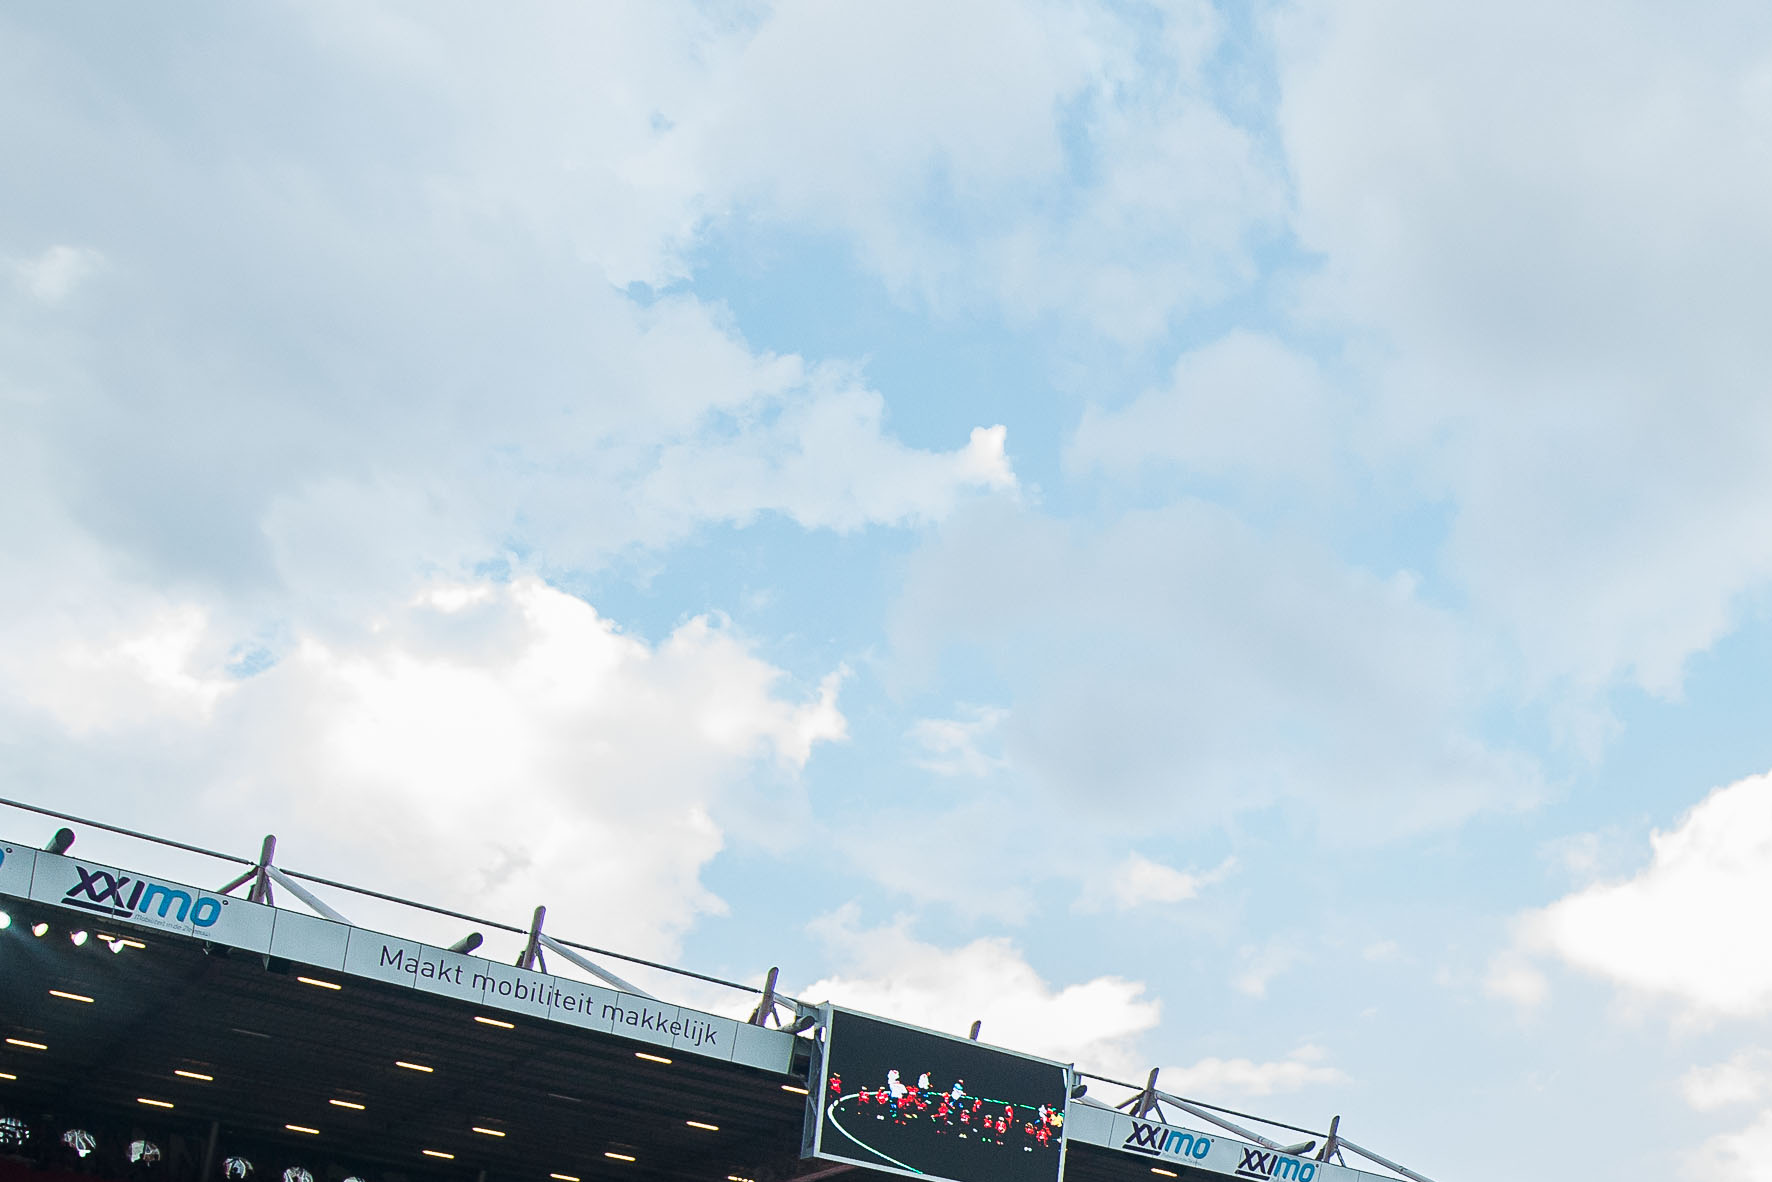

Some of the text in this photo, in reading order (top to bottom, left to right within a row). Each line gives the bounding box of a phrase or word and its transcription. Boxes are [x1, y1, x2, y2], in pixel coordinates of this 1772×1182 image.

[380, 945, 718, 1046] Maakt mobiliteit makkelijk
